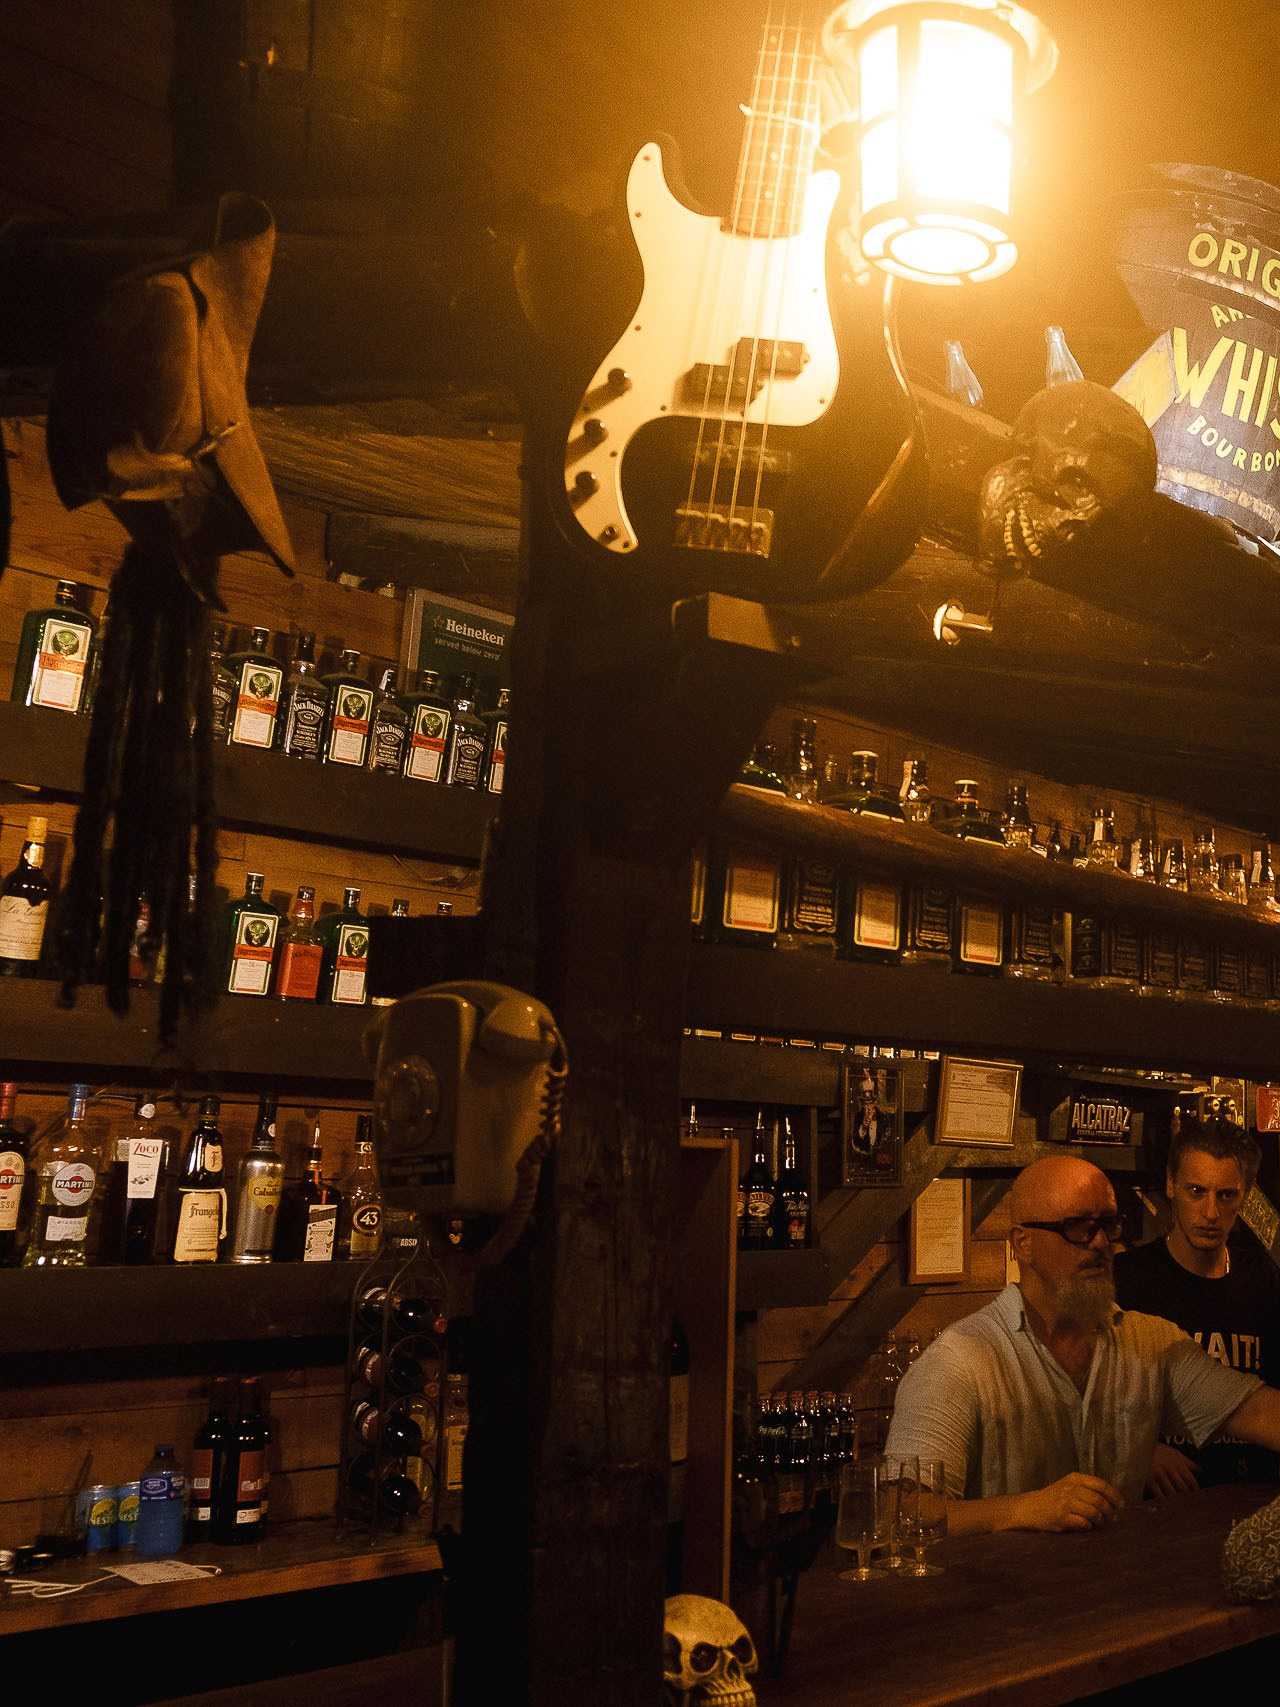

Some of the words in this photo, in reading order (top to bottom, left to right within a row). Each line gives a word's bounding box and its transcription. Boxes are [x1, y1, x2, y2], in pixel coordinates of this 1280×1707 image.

[446, 617, 505, 647] Heineken
[433, 636, 460, 651] served
[461, 642, 482, 656] below
[483, 649, 501, 662] zero
[1072, 1102, 1131, 1131] ALCATRAZ
[56, 1179, 94, 1190] MARTINI
[360, 1211, 379, 1226] 43
